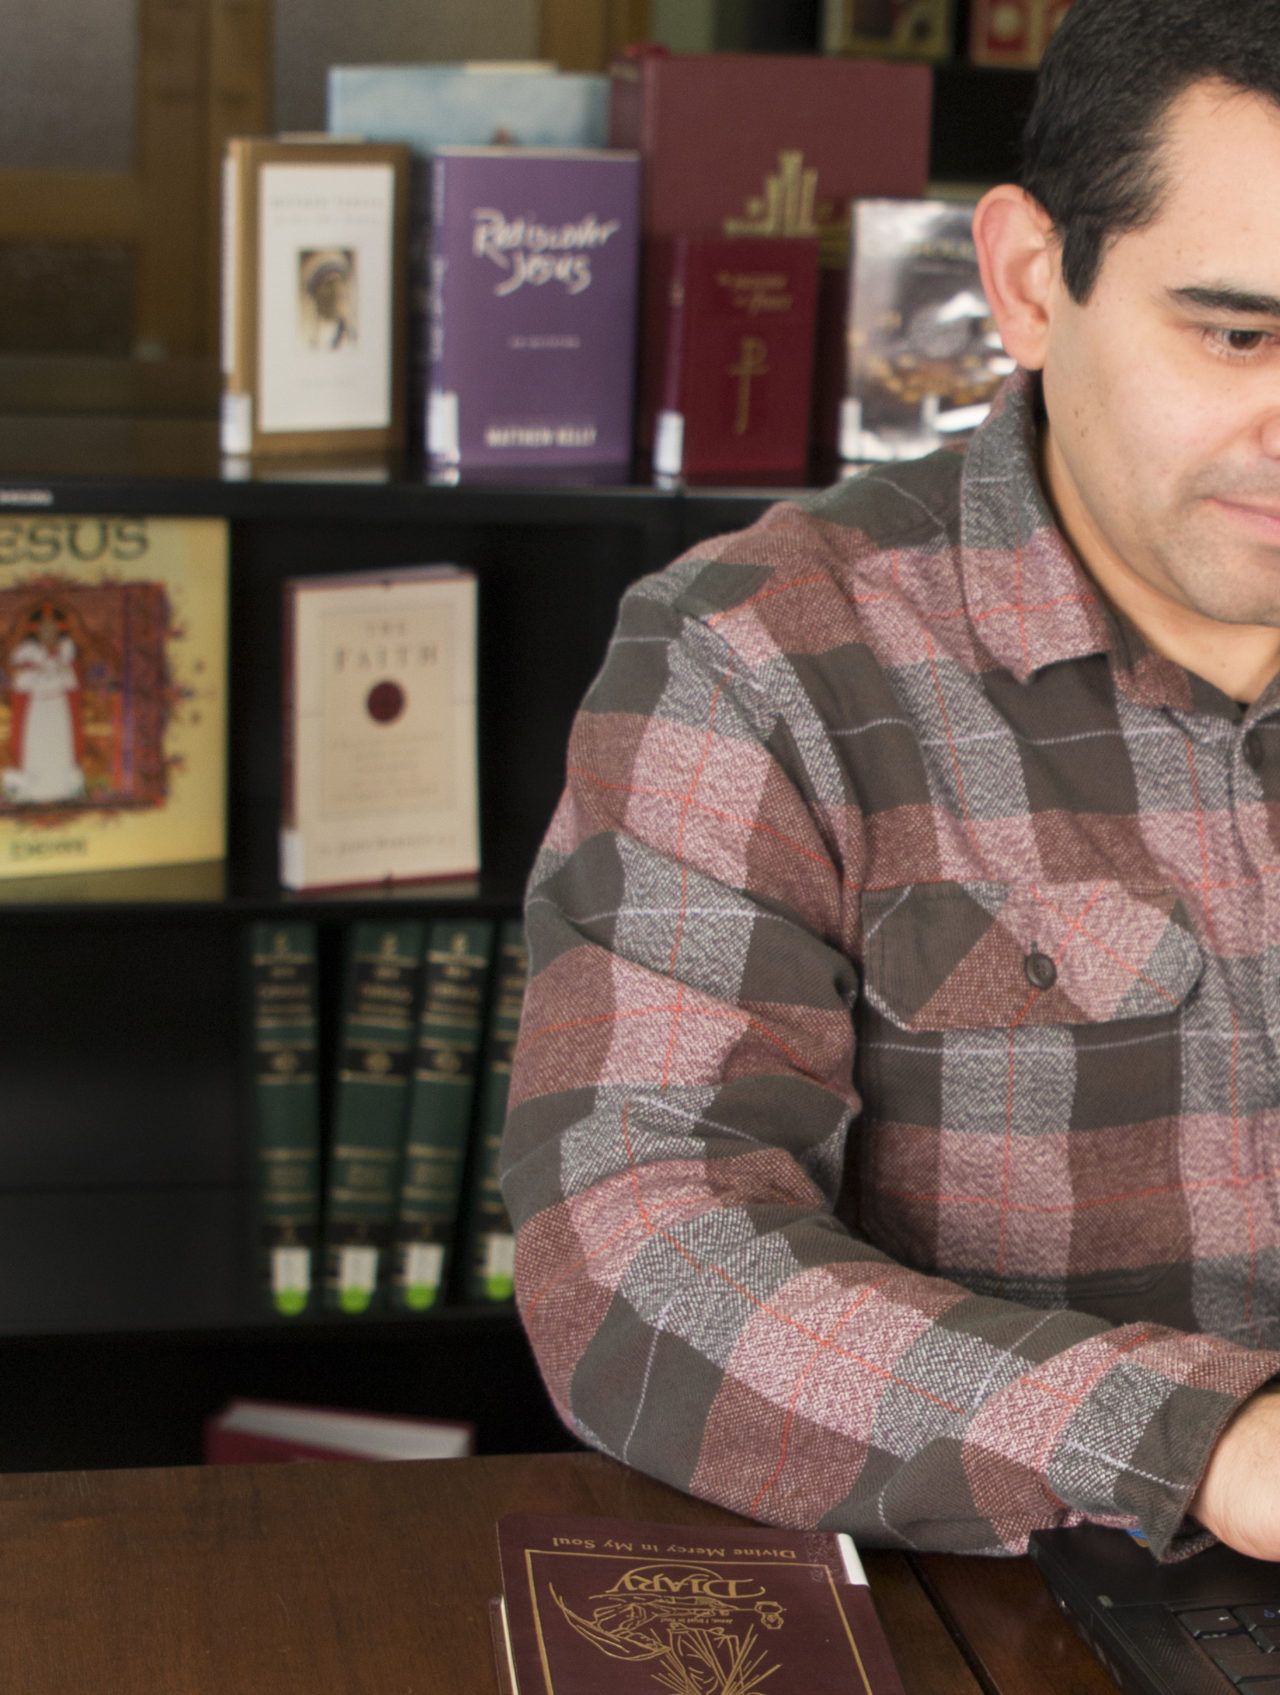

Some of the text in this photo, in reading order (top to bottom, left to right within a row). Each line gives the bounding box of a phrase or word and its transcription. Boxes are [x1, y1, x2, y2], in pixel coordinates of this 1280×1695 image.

[552, 1536, 797, 1559] Divine Mercy in My Soul
[605, 1565, 766, 1599] DIARY
